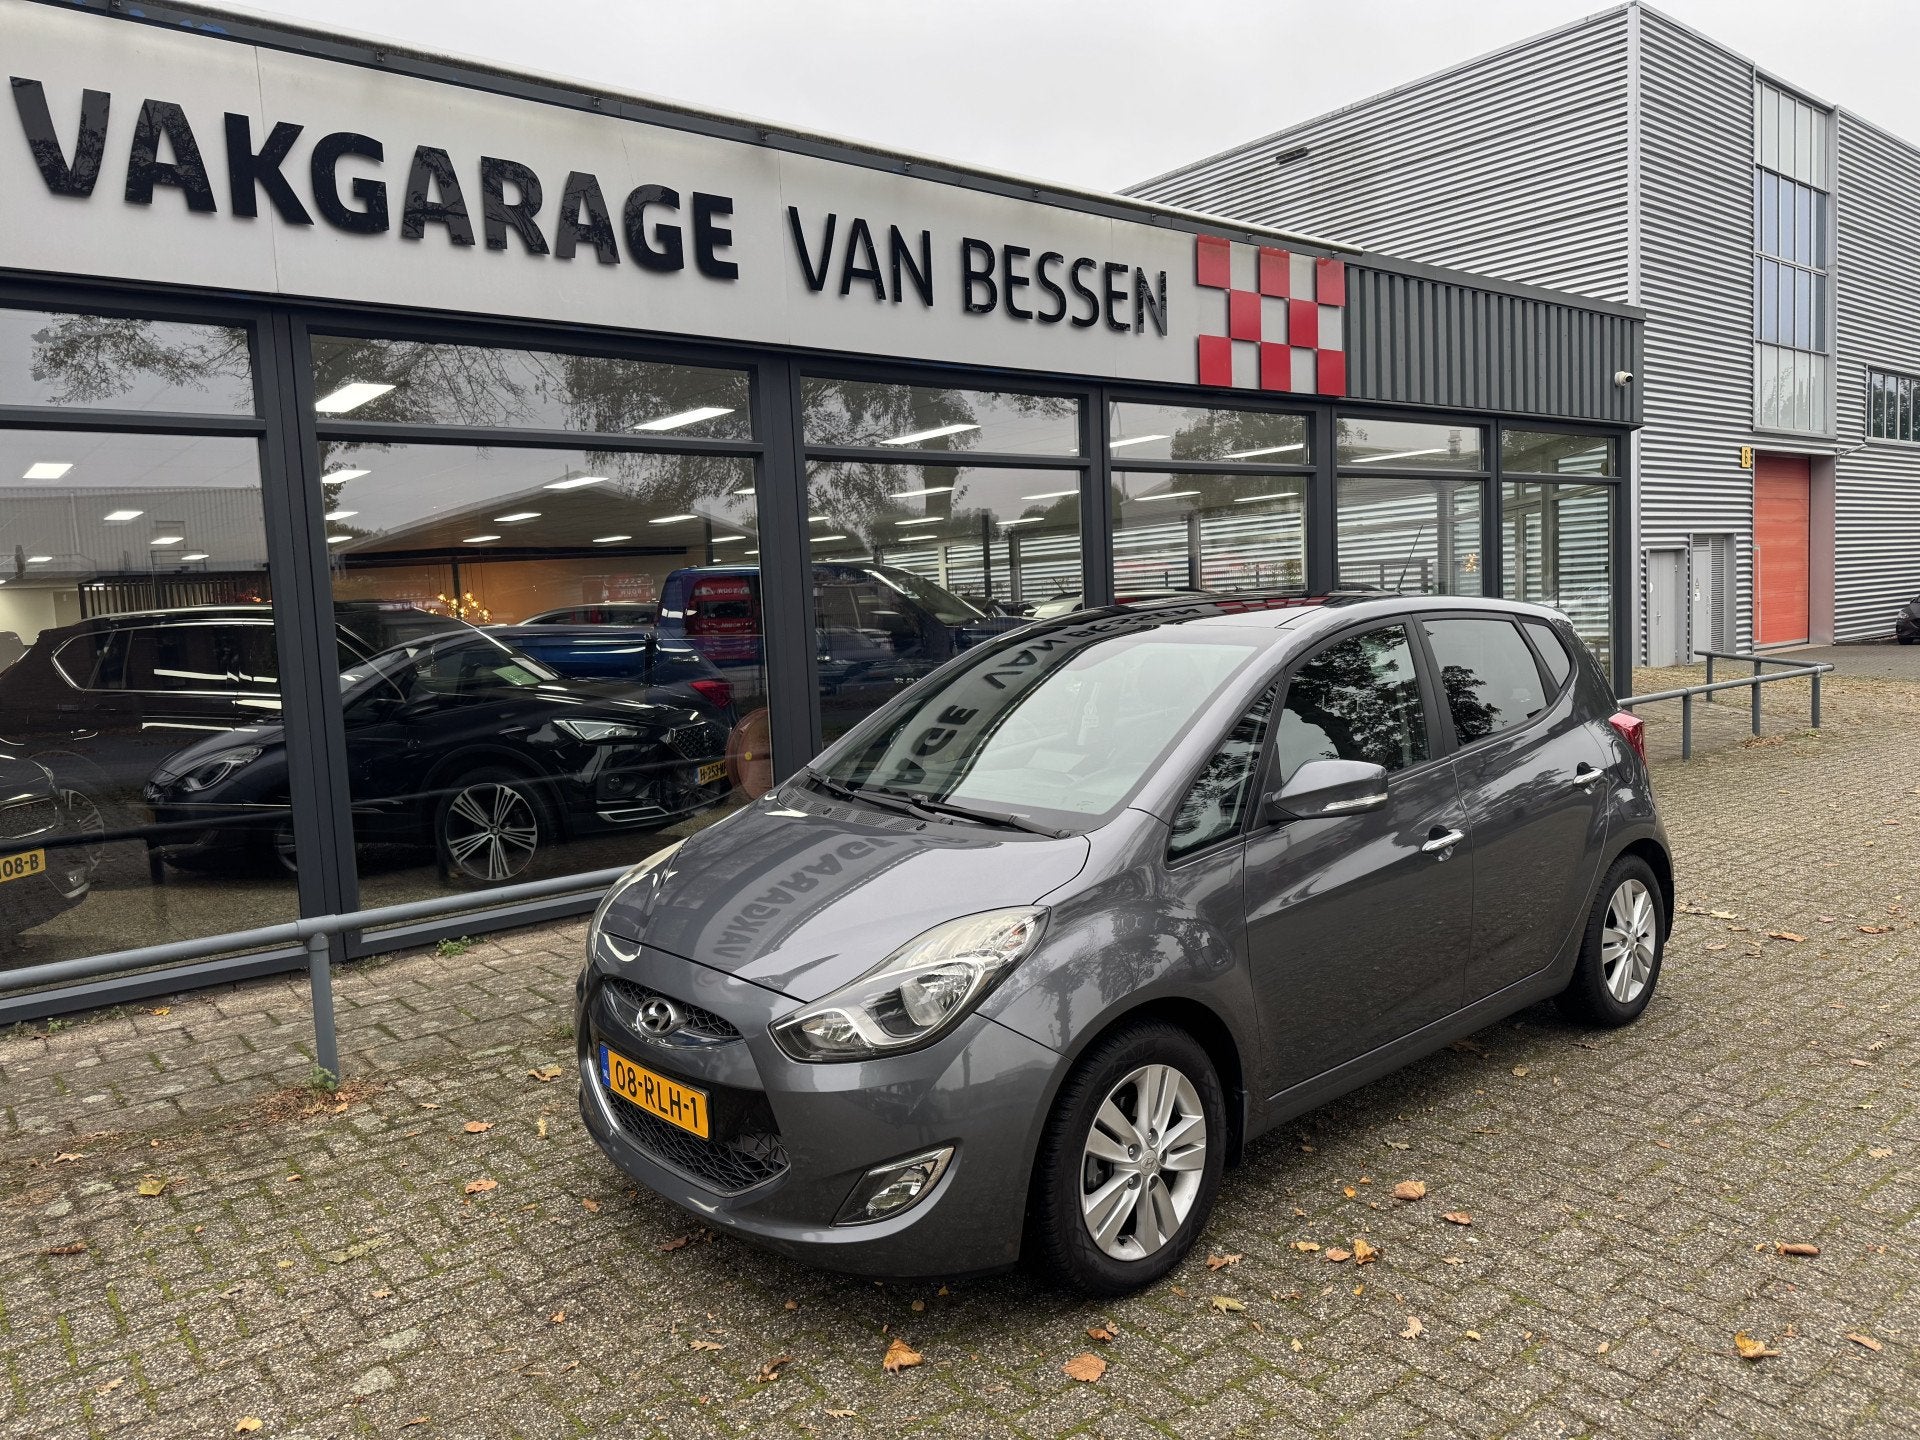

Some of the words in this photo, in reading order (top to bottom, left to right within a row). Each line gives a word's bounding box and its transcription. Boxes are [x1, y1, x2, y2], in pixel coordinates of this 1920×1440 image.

[9, 76, 740, 280] VAKGARAGE
[788, 205, 934, 307] VAN
[962, 237, 1168, 337] BESSEN
[0, 853, 39, 880] 08-B
[615, 1060, 698, 1128] 08-RLH-1
